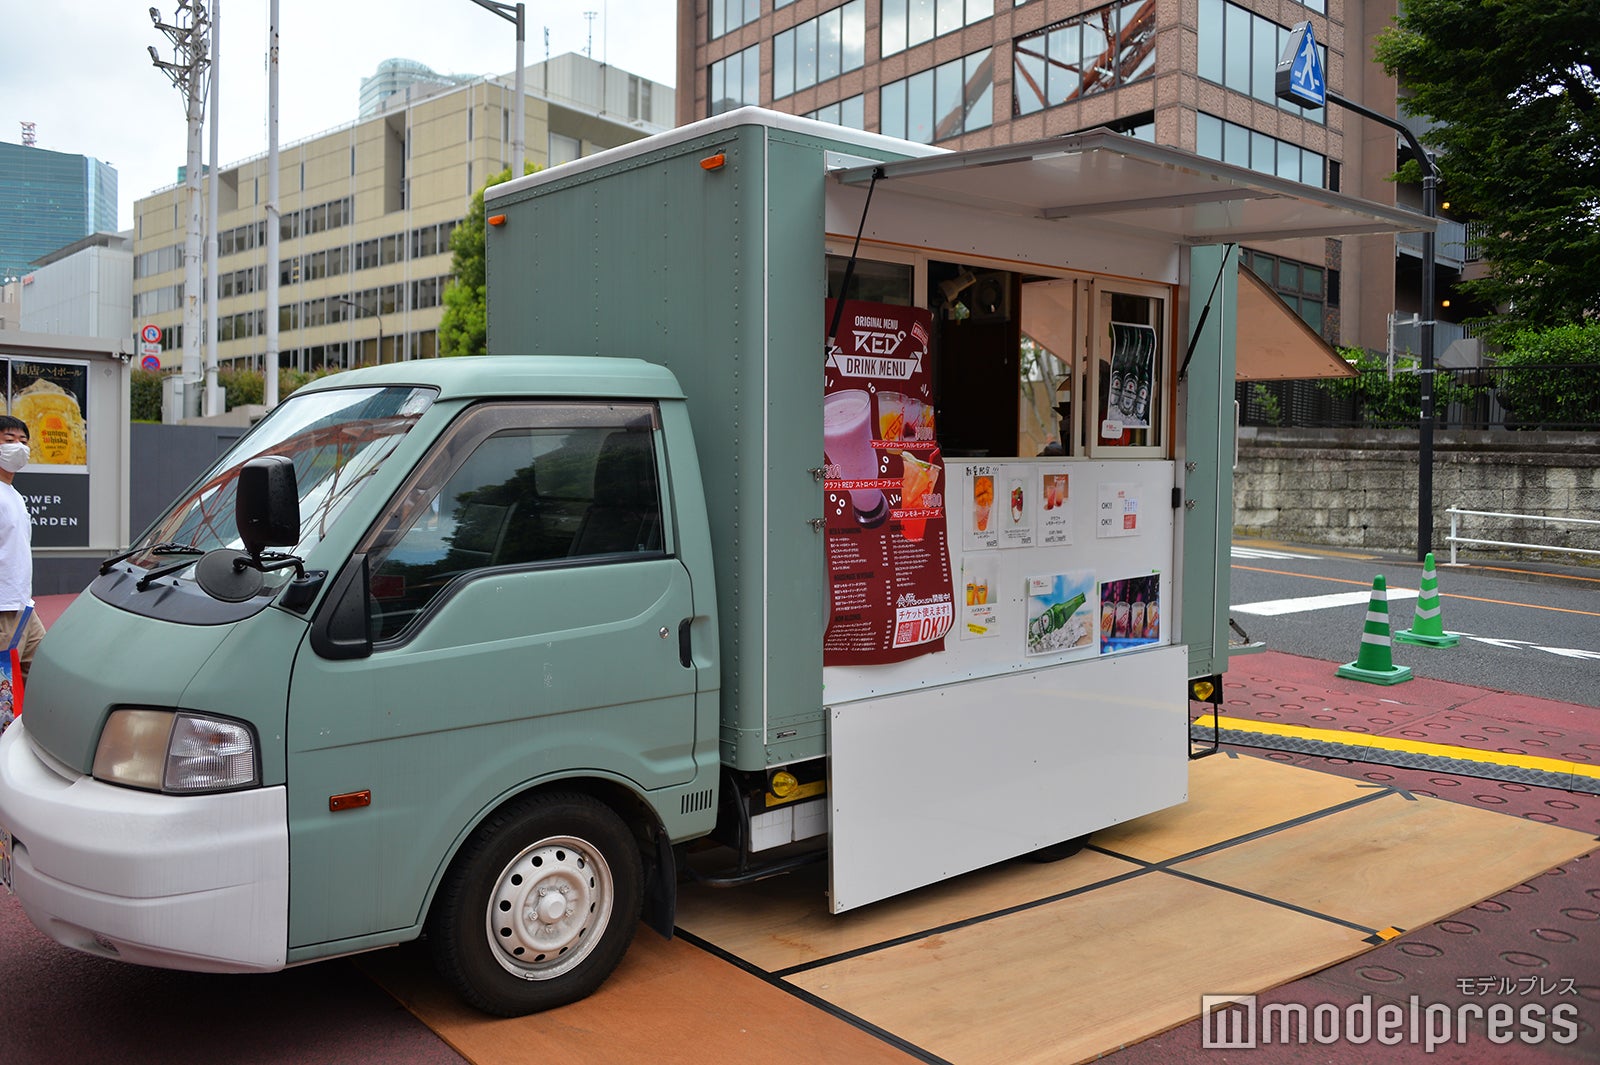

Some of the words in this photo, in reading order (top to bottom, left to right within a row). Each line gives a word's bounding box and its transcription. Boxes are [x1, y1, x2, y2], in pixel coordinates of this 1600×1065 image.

[854, 315, 882, 329] ORIGINAL
[883, 318, 899, 330] MENU
[846, 358, 877, 375] DRINK
[879, 359, 906, 377] MENU
[921, 615, 950, 641] OK!!
